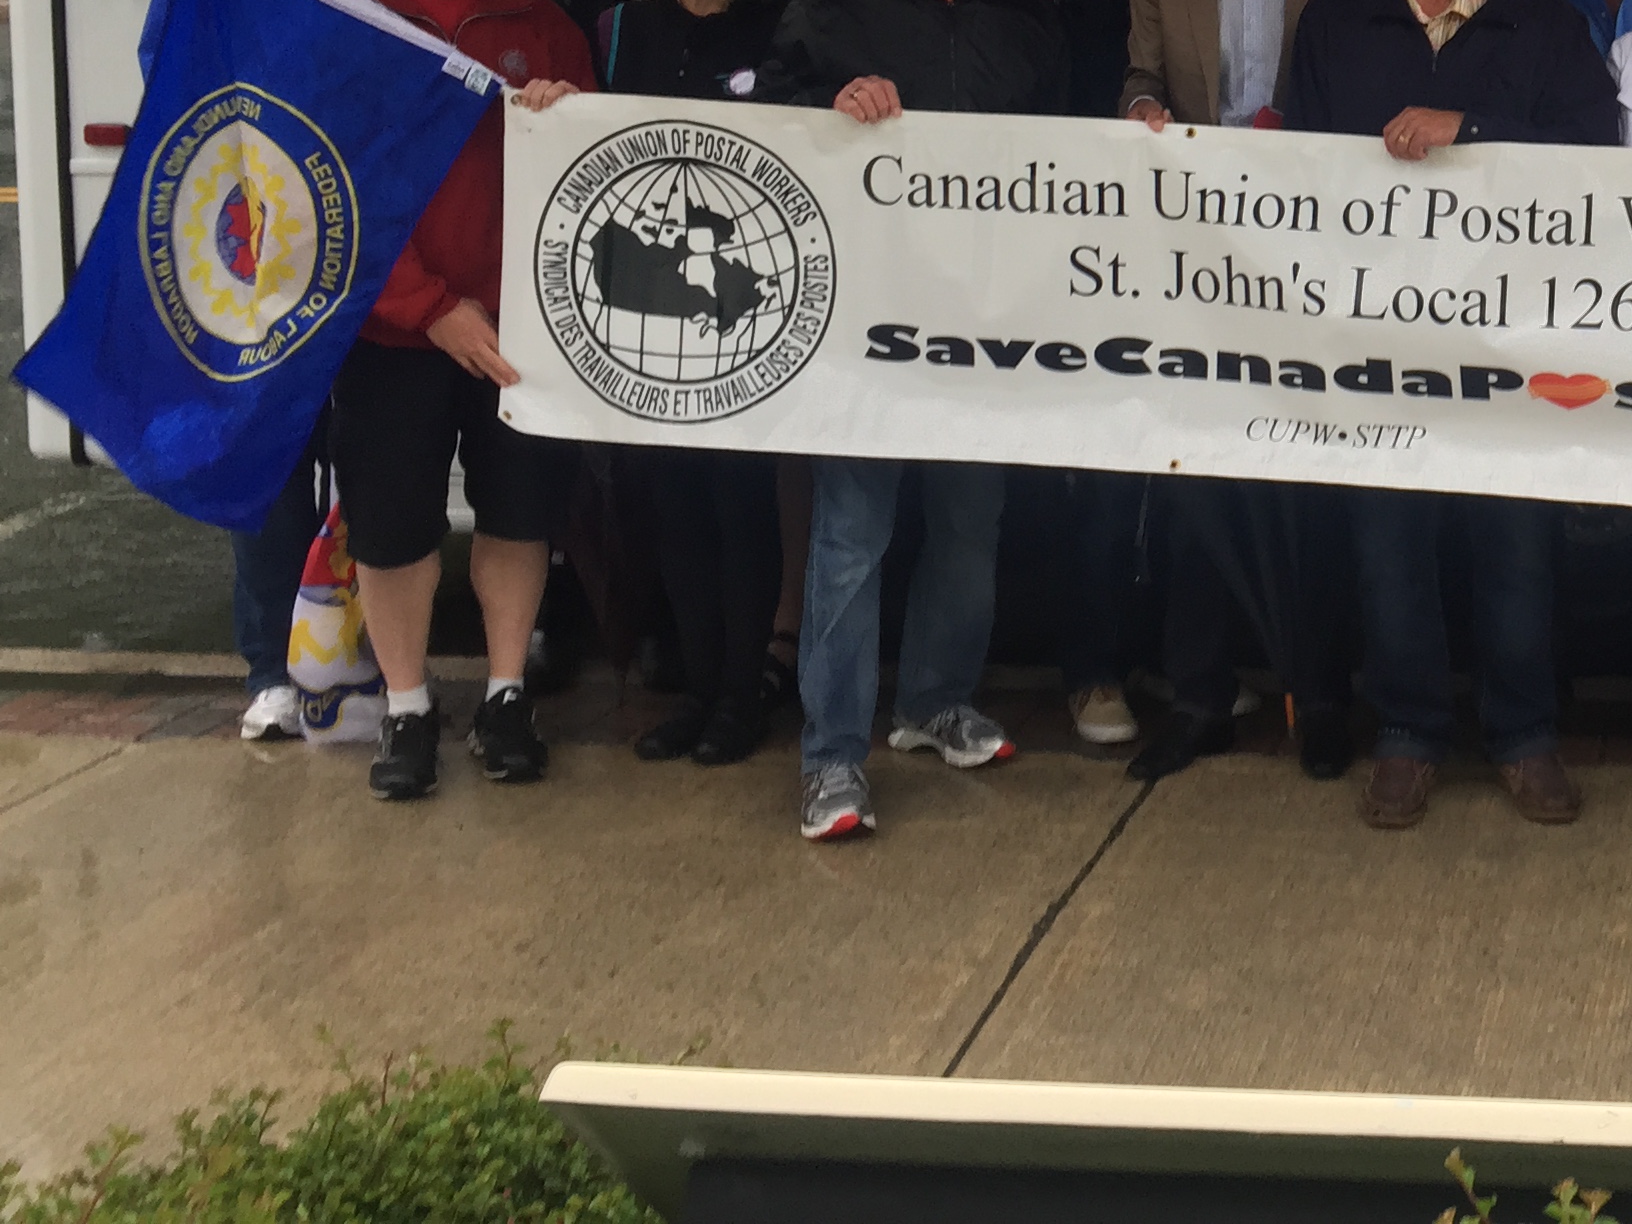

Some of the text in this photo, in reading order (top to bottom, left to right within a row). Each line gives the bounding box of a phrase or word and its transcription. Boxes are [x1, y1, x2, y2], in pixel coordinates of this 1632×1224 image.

[556, 128, 818, 229] CANADIAN UNION OF POSTAL WORKERS
[863, 154, 1130, 218] Canadian
[1149, 168, 1323, 233] Union
[1342, 184, 1411, 238] of
[1418, 187, 1597, 248] Postal
[542, 238, 830, 417] SYNDICAT DES TRAVAILLEURS ET TRAVAILLEUSES DES POSTES
[1069, 244, 1142, 299] St.
[1163, 249, 1328, 317] John's
[1345, 265, 1511, 328] Local
